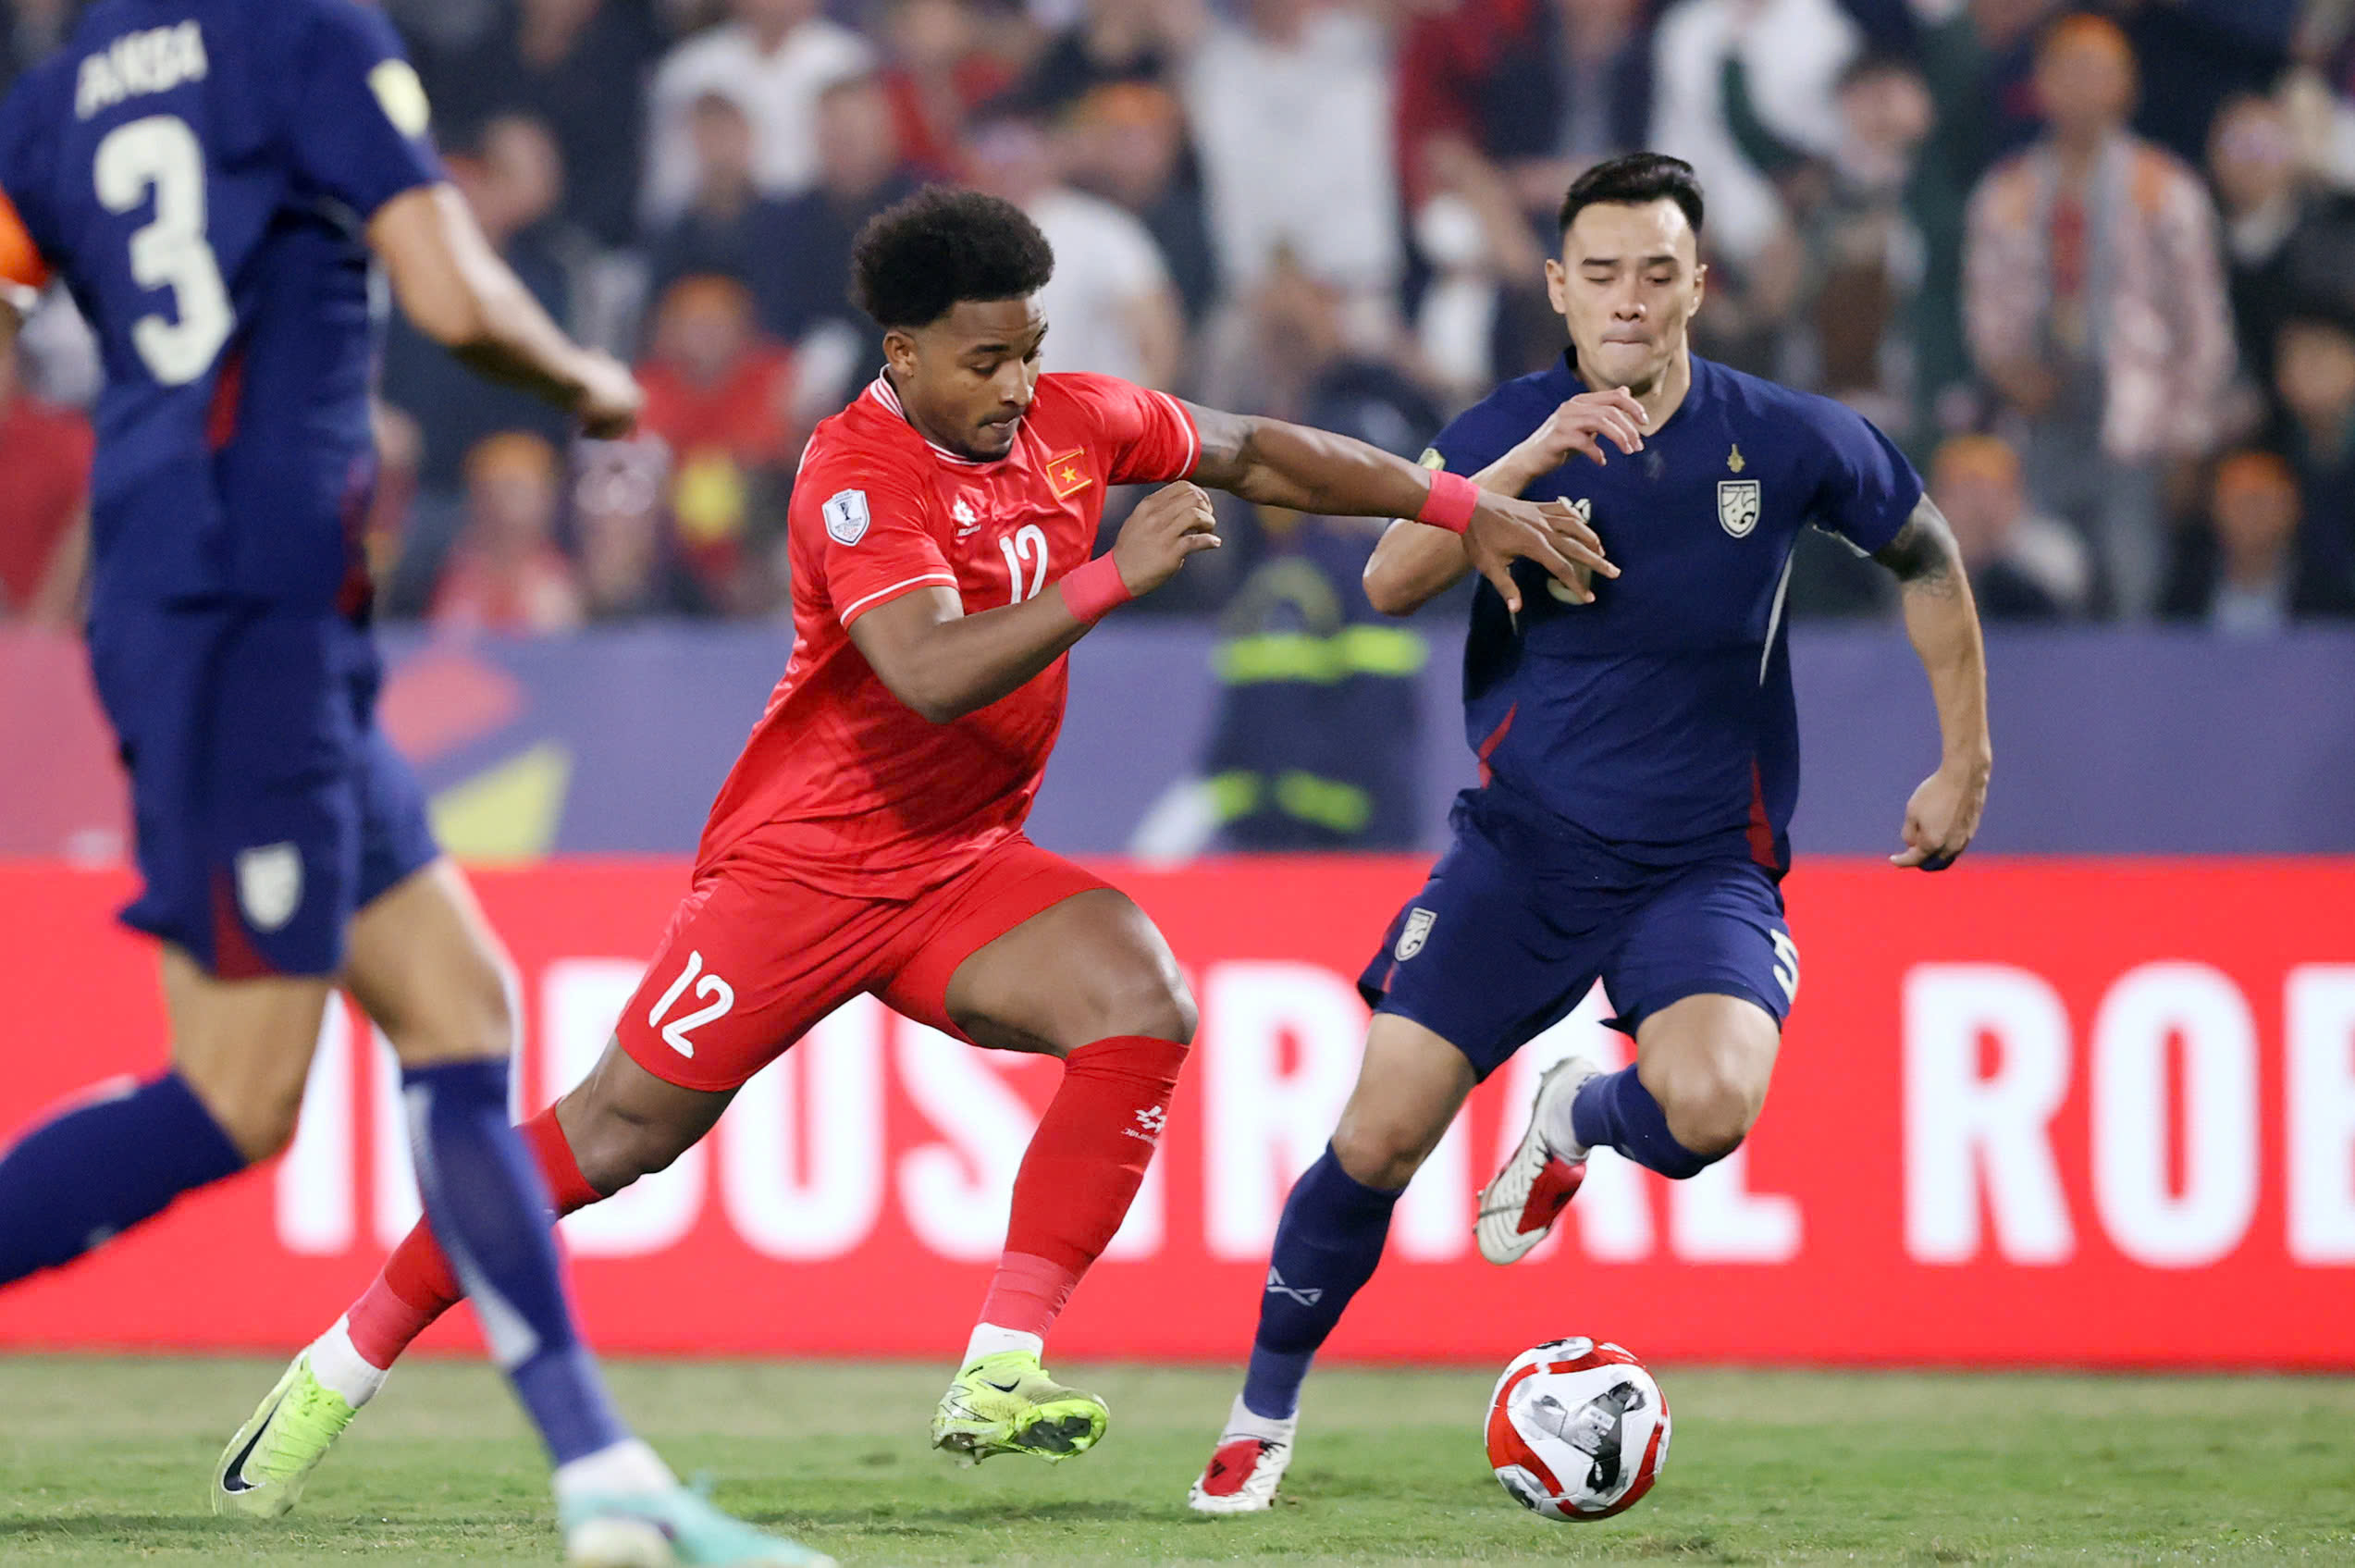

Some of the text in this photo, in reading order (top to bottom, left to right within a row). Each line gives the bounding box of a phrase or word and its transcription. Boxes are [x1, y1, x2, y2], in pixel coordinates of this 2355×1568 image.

[95, 115, 236, 385] 3
[998, 524, 1049, 605] 12
[648, 949, 735, 1059] 12
[276, 963, 1803, 1261] IDUSRA
